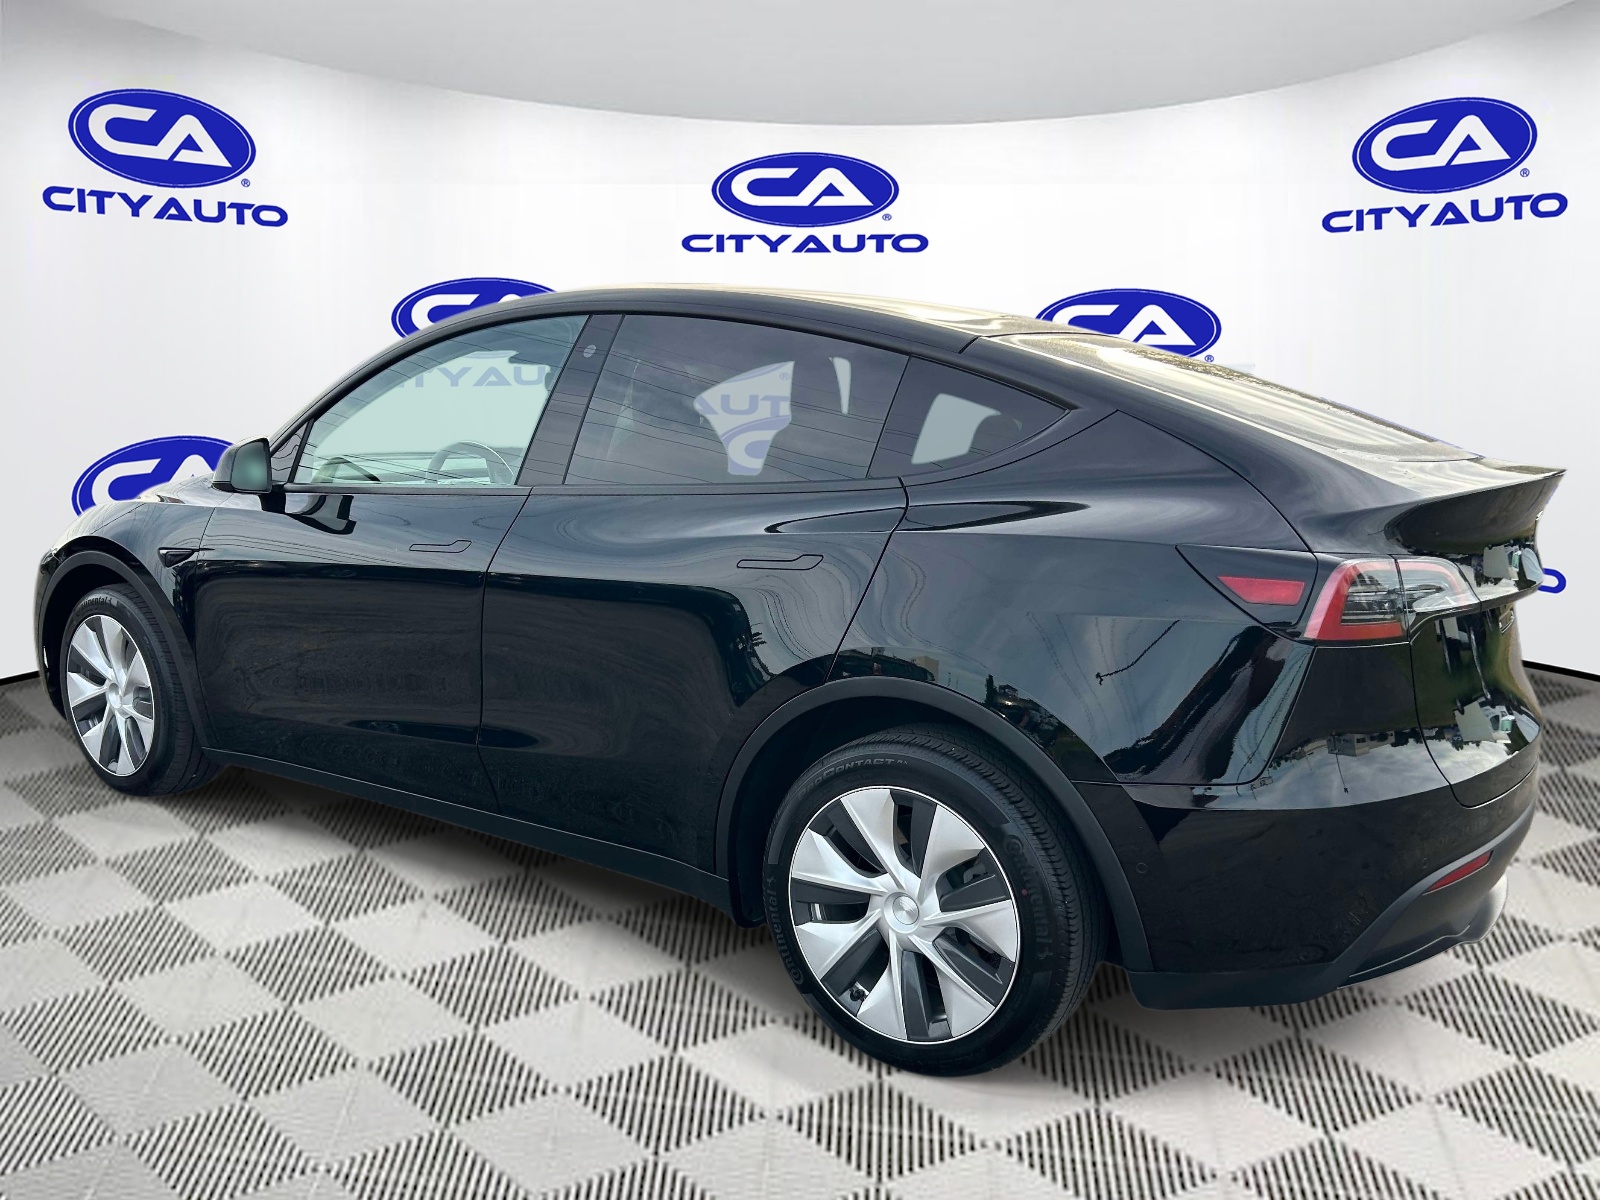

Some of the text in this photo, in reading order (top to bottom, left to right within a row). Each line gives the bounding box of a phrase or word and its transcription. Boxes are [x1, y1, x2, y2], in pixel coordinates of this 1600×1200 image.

[89, 103, 232, 168] CA
[1371, 114, 1511, 172] CA
[731, 167, 874, 207] CA
